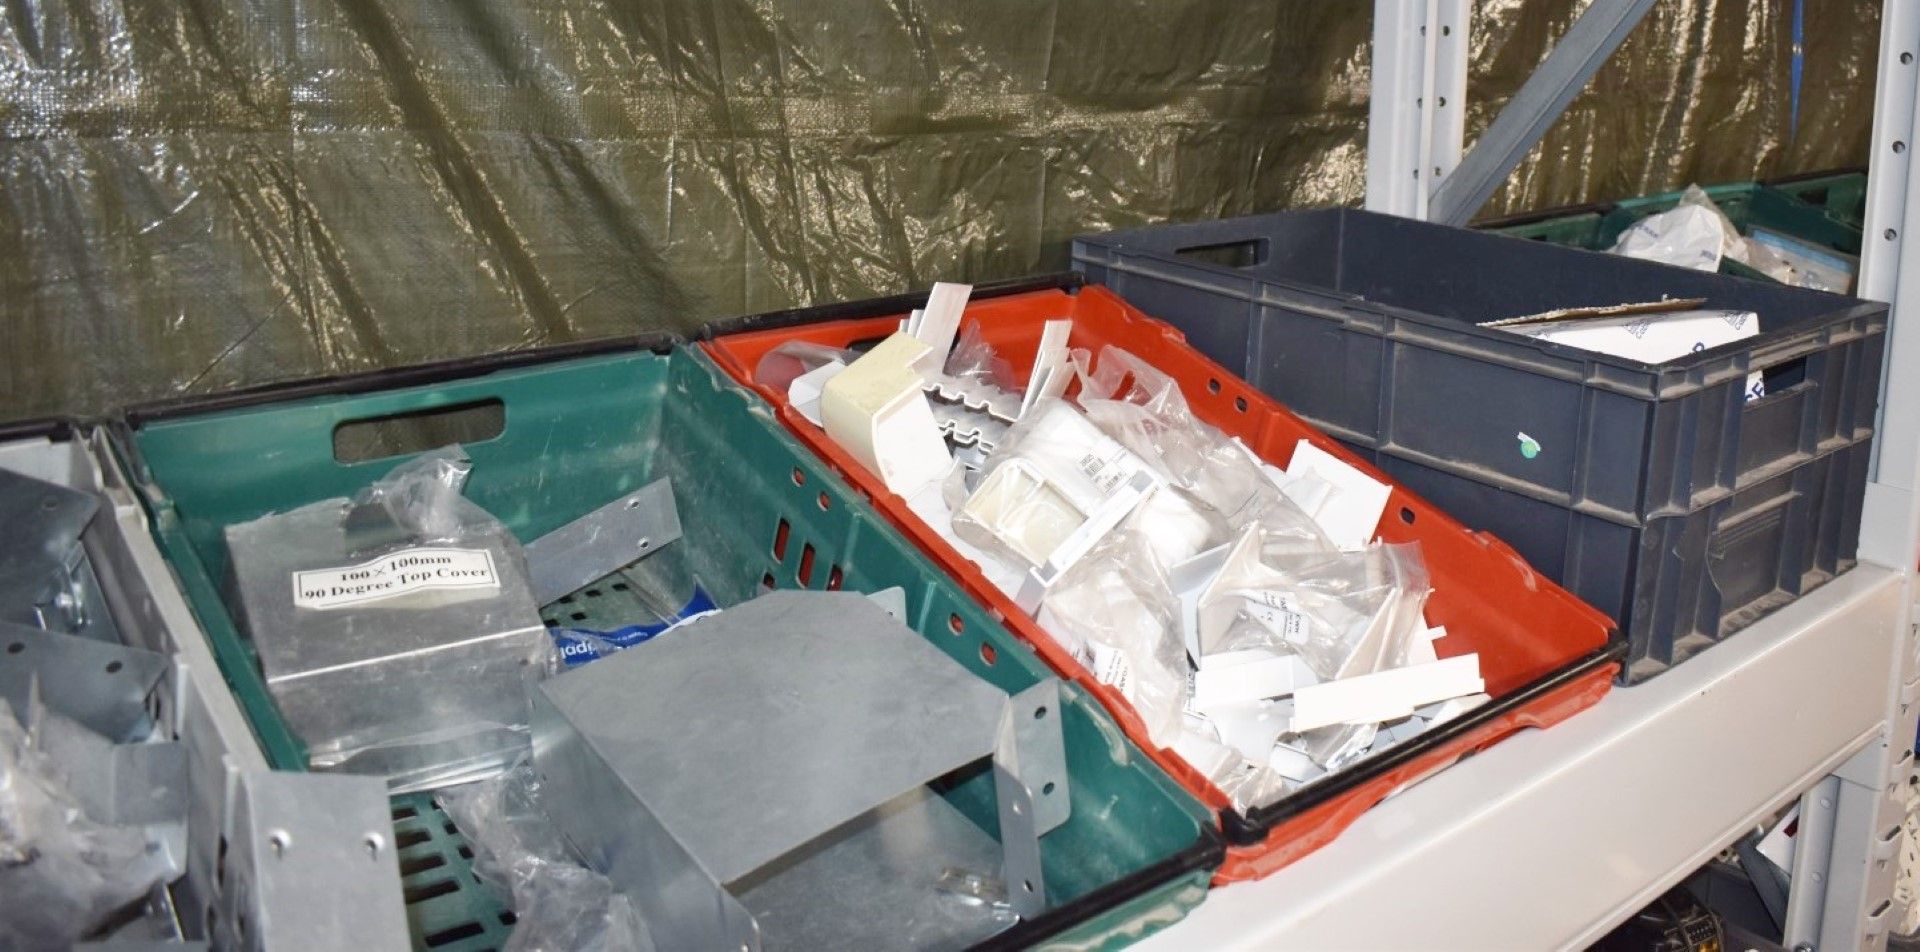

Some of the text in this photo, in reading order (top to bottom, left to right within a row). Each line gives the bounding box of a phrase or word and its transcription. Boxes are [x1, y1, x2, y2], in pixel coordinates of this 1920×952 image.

[304, 566, 489, 600] 90 Degree Top Cover
[340, 569, 371, 583] 100
[390, 555, 453, 572] 100mm
